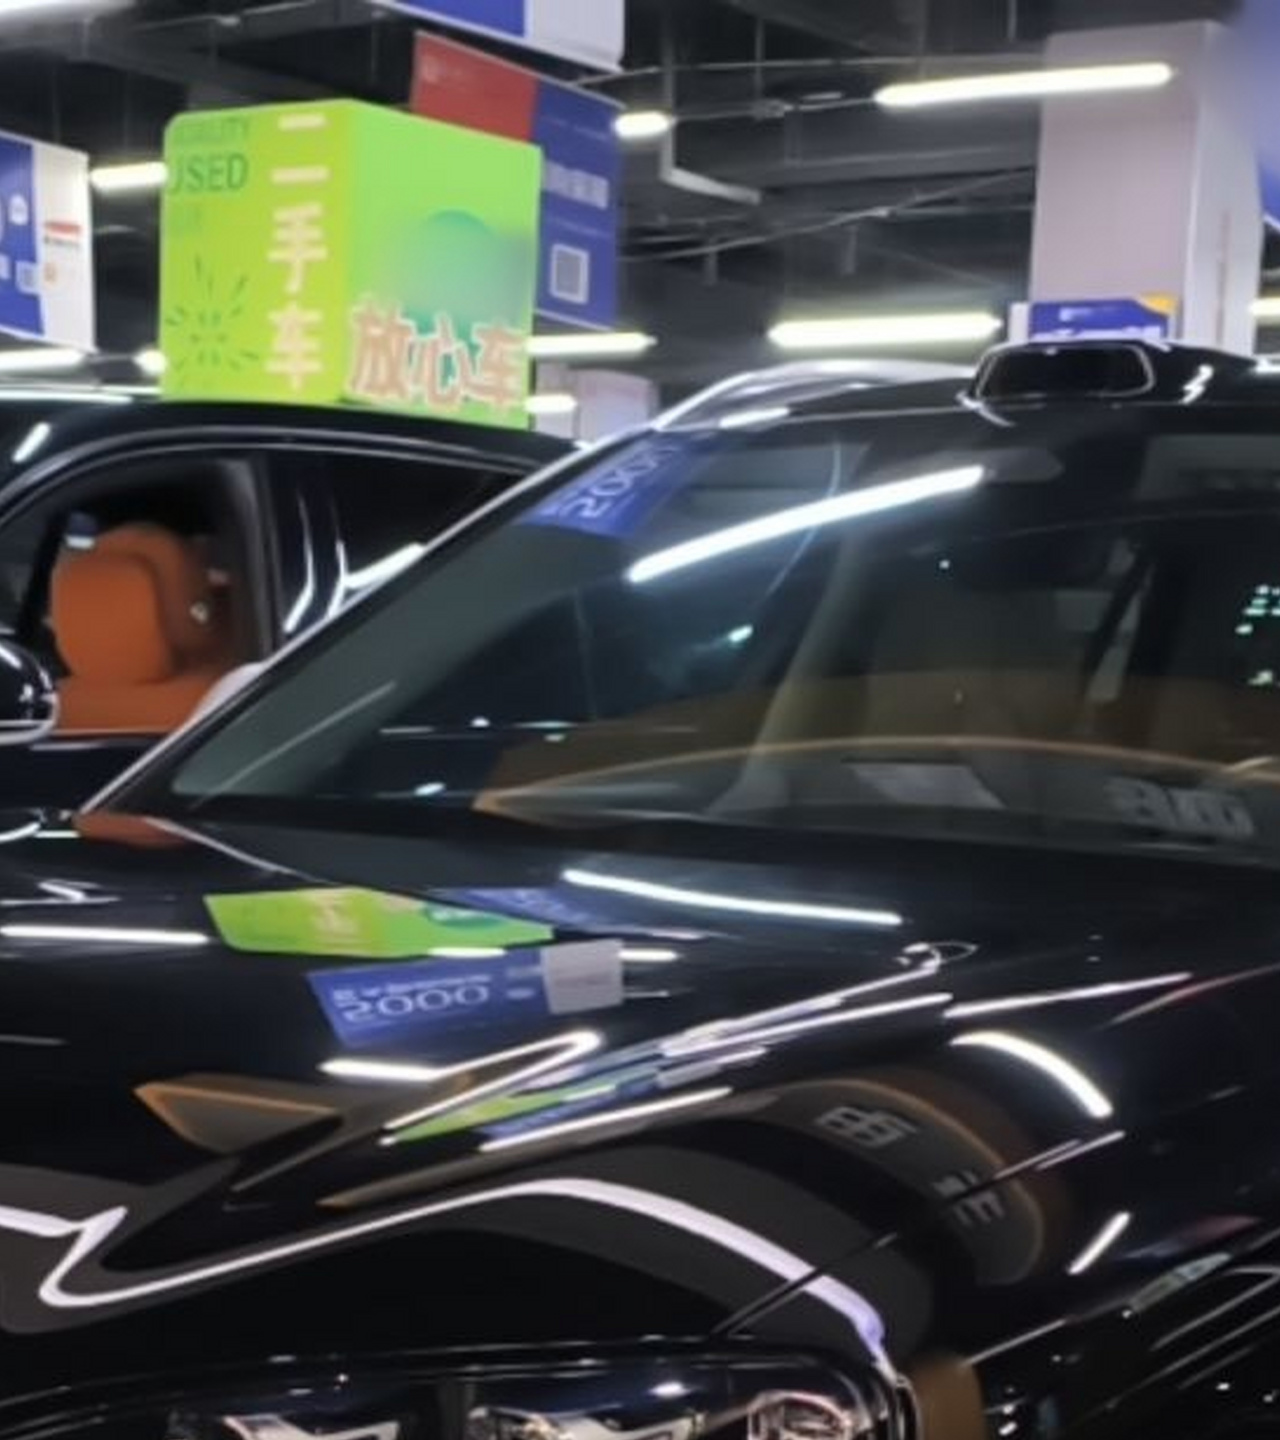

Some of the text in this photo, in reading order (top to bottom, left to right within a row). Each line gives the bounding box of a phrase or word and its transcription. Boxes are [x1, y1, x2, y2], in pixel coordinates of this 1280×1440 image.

[266, 111, 331, 392] 二手车
[346, 294, 526, 414] 放心车
